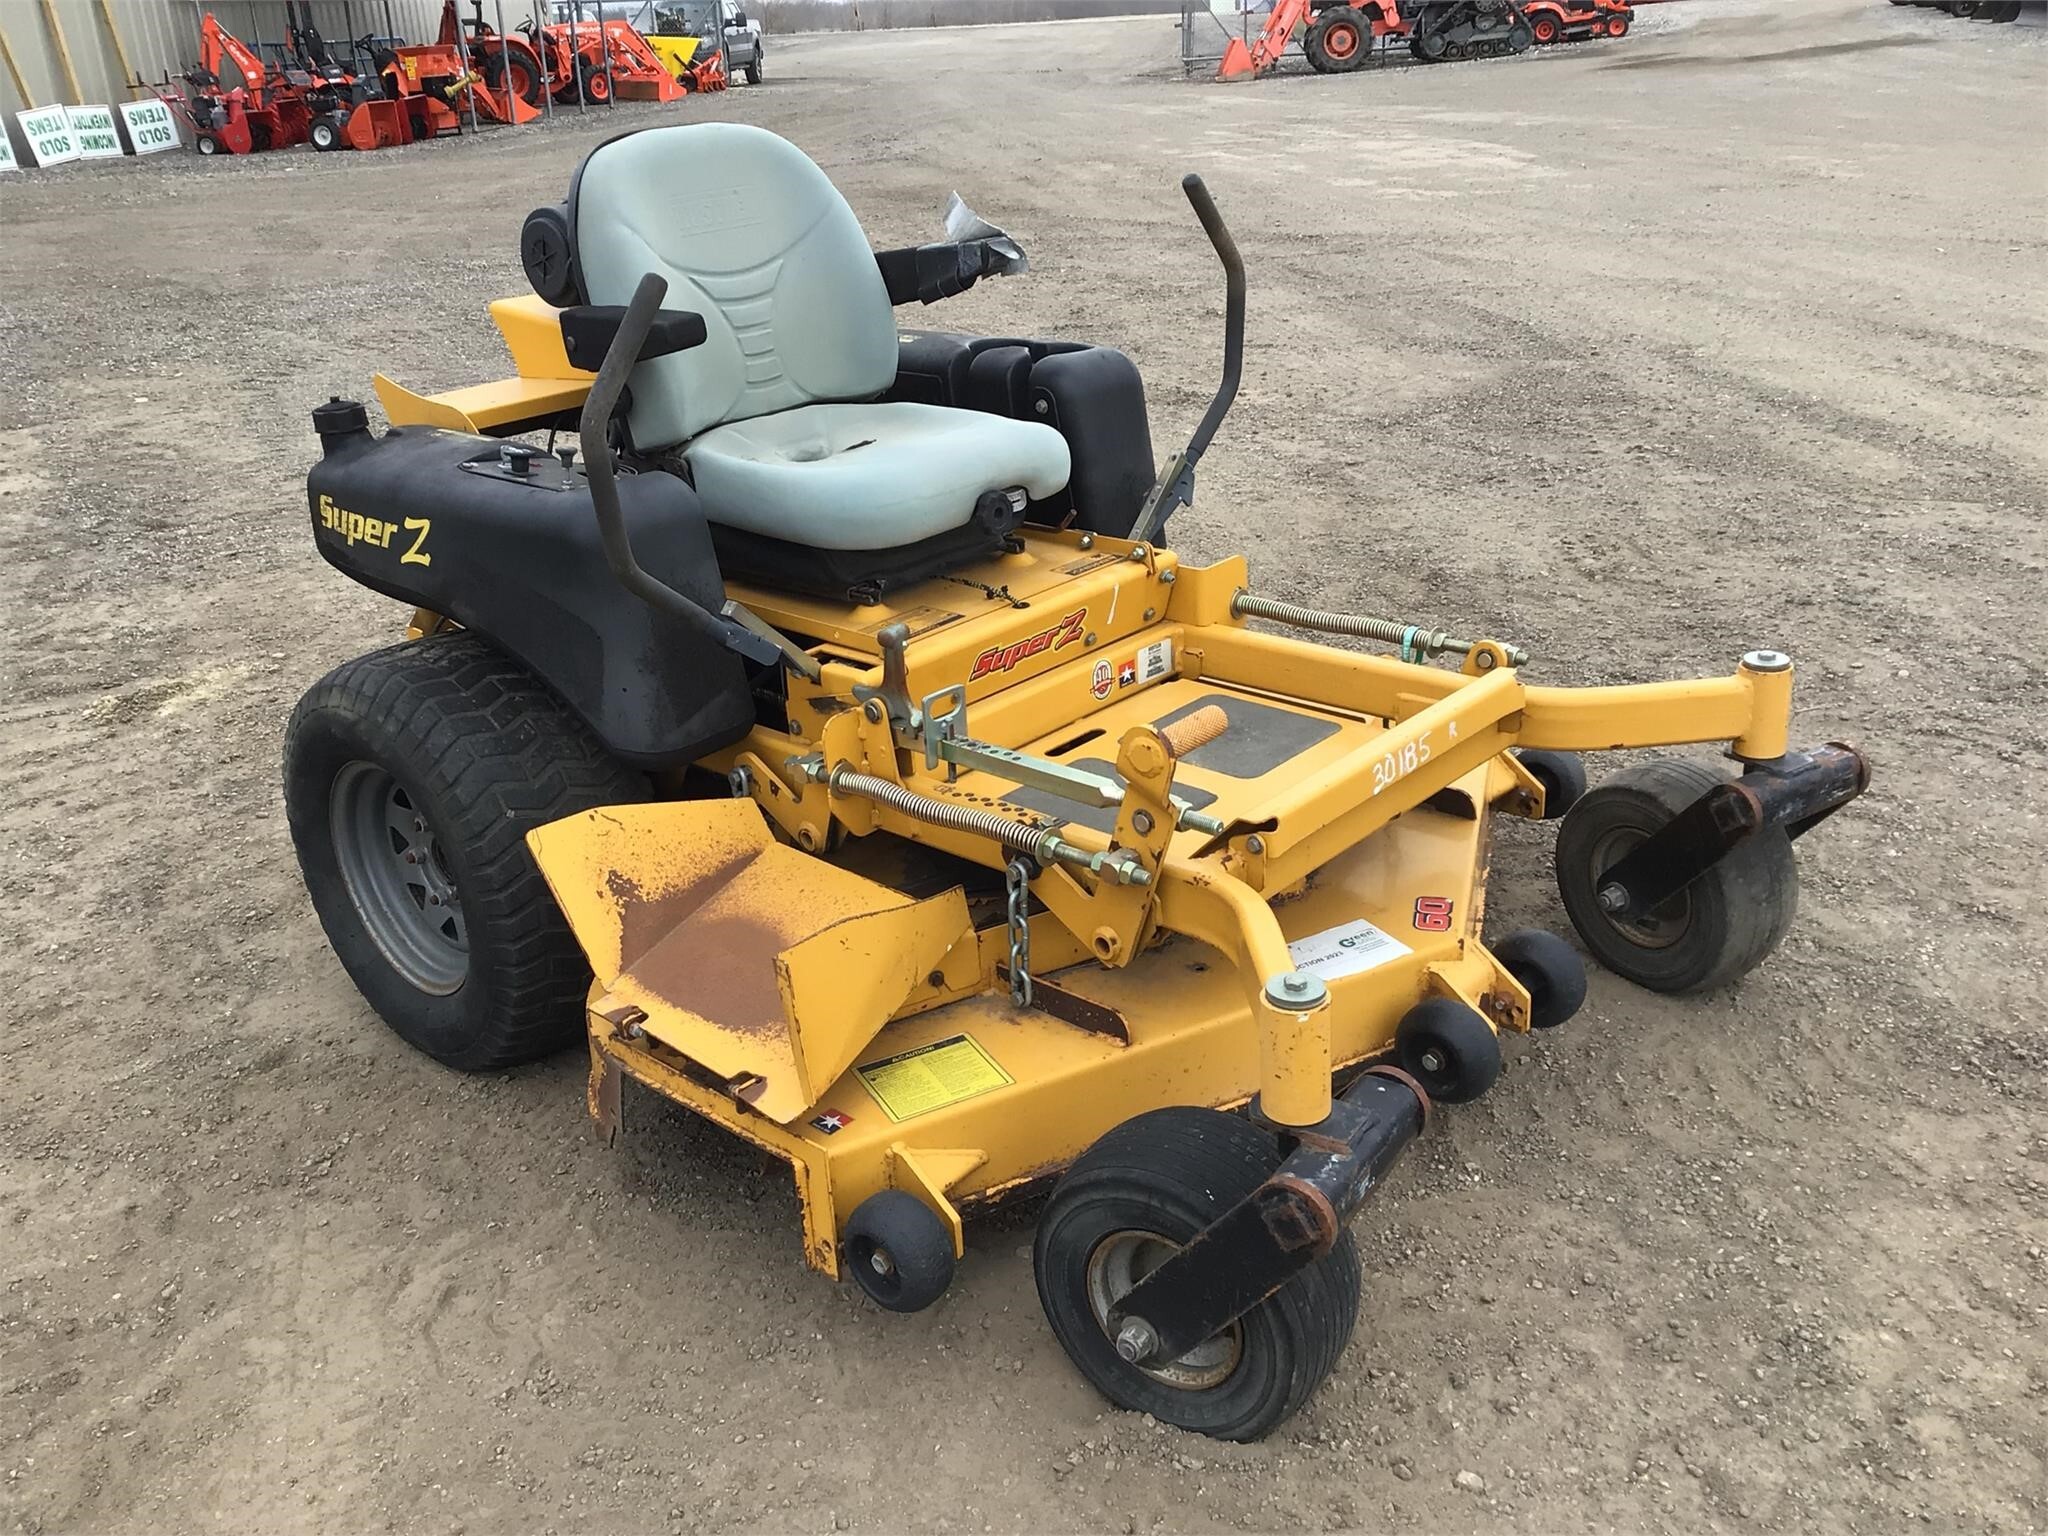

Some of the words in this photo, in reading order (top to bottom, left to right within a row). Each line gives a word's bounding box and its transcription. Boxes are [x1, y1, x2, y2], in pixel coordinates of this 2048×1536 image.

[26, 113, 65, 137] ITEMS
[73, 114, 113, 131] INVENTORY
[129, 106, 168, 126] ITEMS
[79, 134, 117, 151] INCOMING
[139, 126, 171, 145] SOLD
[39, 136, 71, 156] SOLD
[320, 494, 398, 547] Super
[400, 516, 431, 567] Z
[1372, 731, 1432, 796] 30185
[1413, 896, 1453, 931] 60
[1339, 929, 1375, 948] Green
